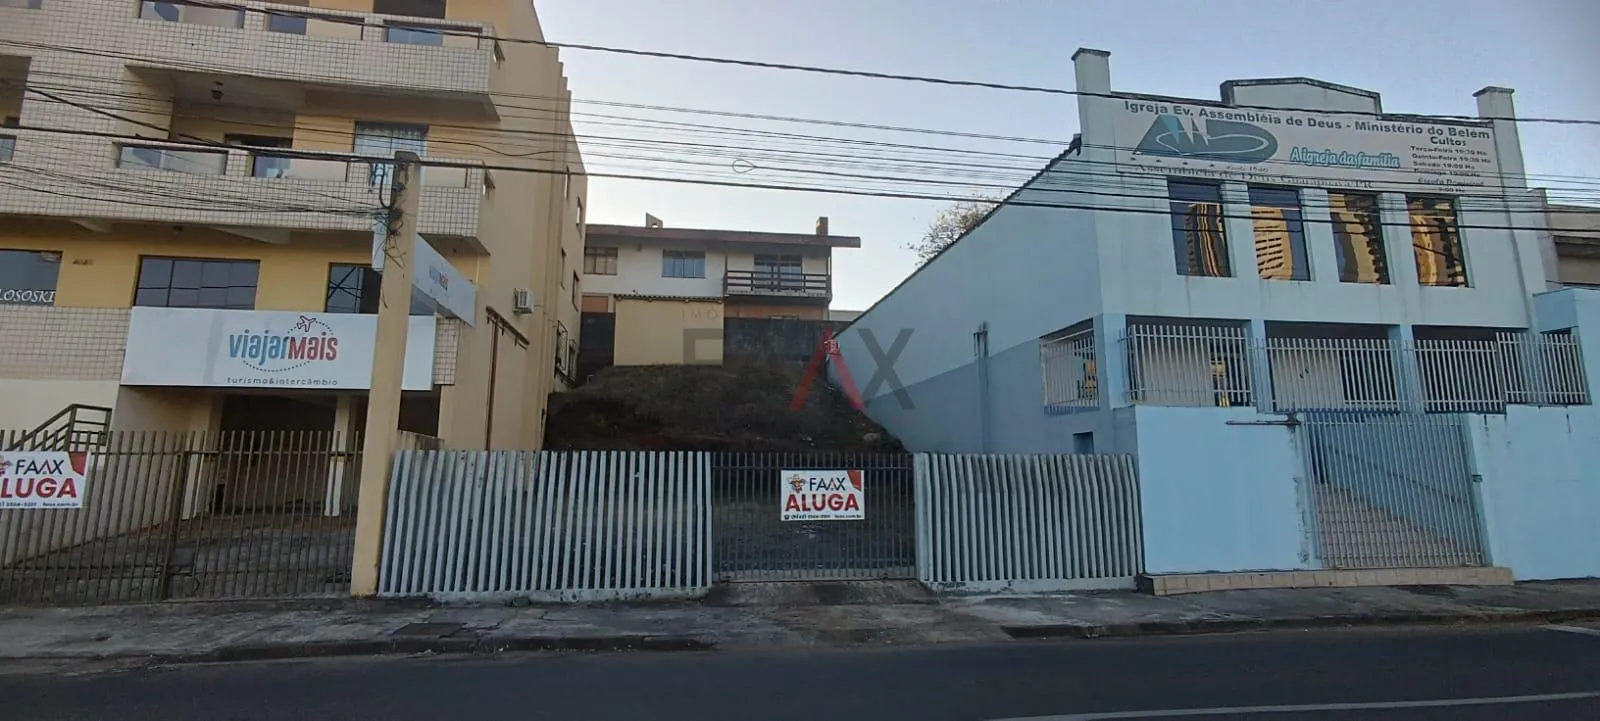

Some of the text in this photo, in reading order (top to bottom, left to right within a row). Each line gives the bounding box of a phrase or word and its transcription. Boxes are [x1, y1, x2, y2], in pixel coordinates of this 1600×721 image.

[1124, 100, 1168, 115] Igreja
[1172, 105, 1194, 117] Ev.
[1286, 116, 1303, 127] de
[1307, 117, 1342, 129] Deus
[1354, 121, 1423, 135] Ministério
[1428, 126, 1444, 136] do
[1430, 136, 1467, 147] Cultos
[1338, 150, 1357, 166] da
[785, 493, 859, 511] ALUGA
